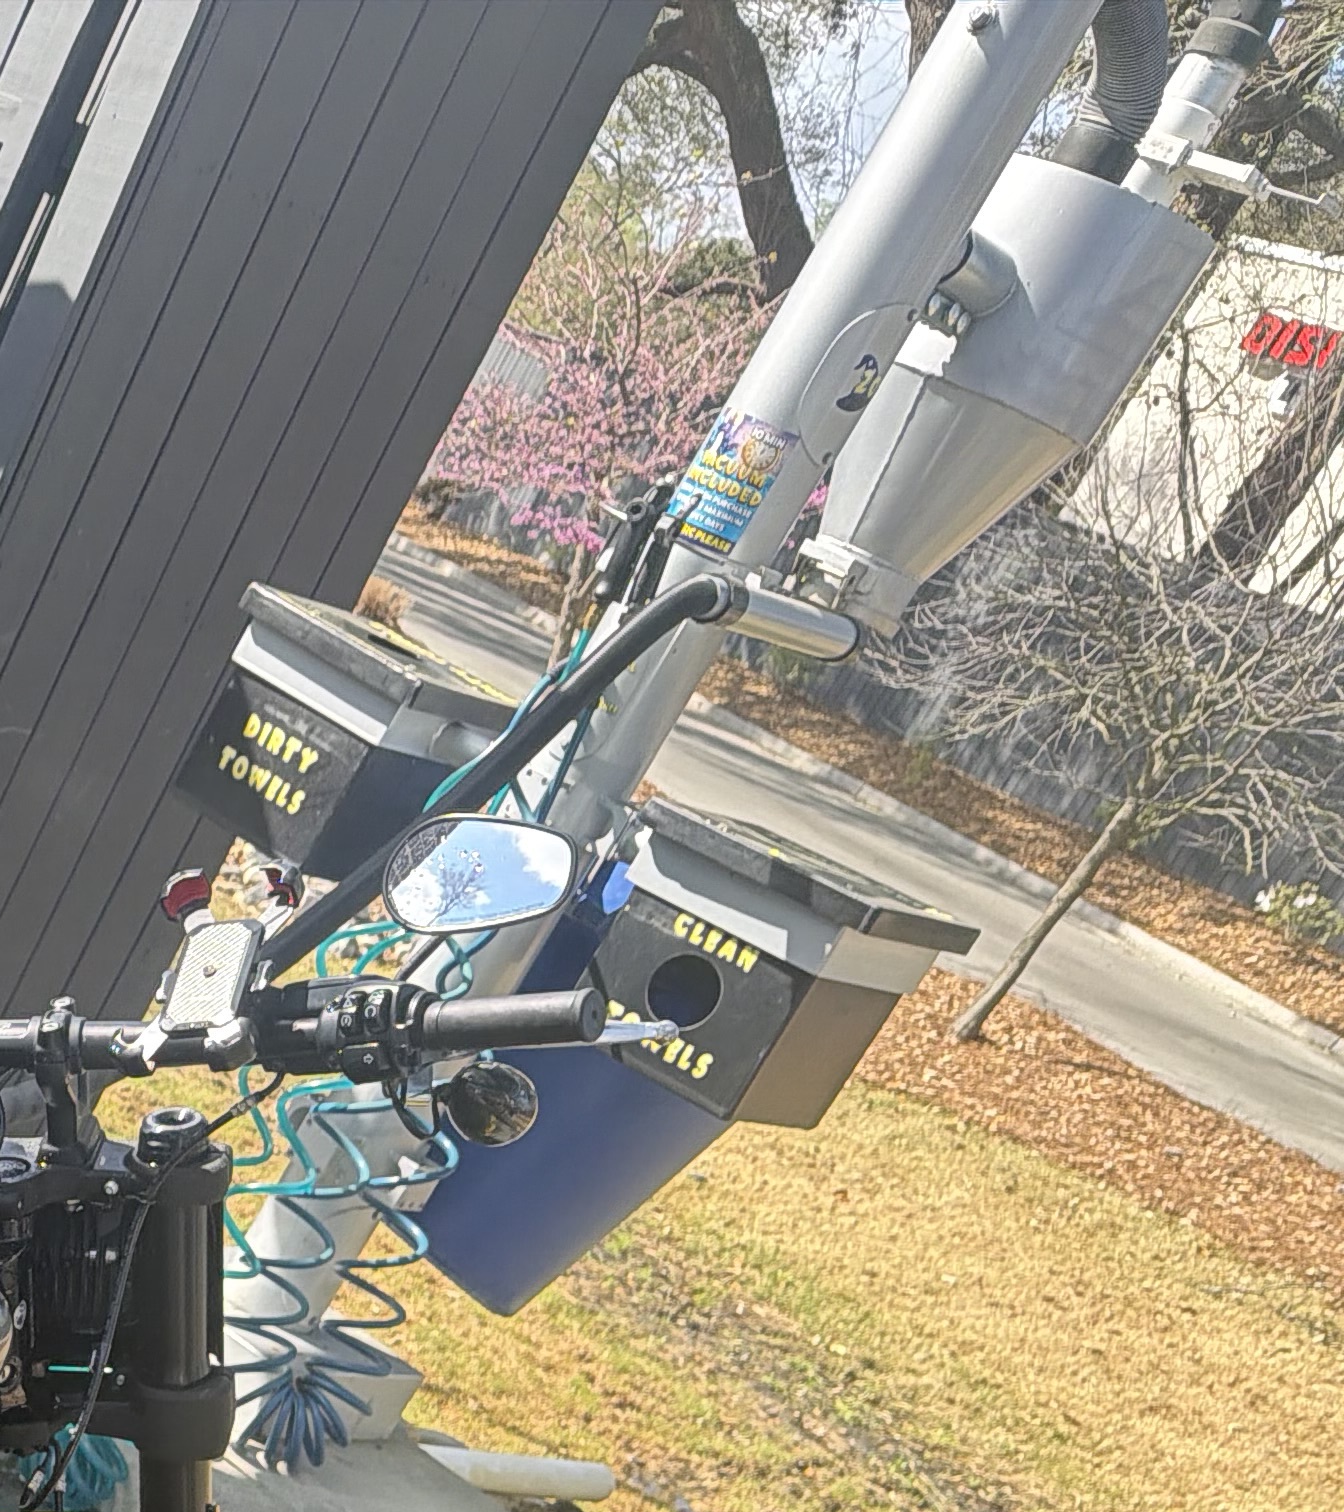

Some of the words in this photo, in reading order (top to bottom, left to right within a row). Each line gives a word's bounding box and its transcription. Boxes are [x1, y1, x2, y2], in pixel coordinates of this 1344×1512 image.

[764, 431, 787, 449] MIN
[694, 527, 732, 553] PLEASE
[243, 713, 318, 773] DIRTY
[218, 745, 306, 815] TOWELS
[674, 912, 760, 974] CLEAN
